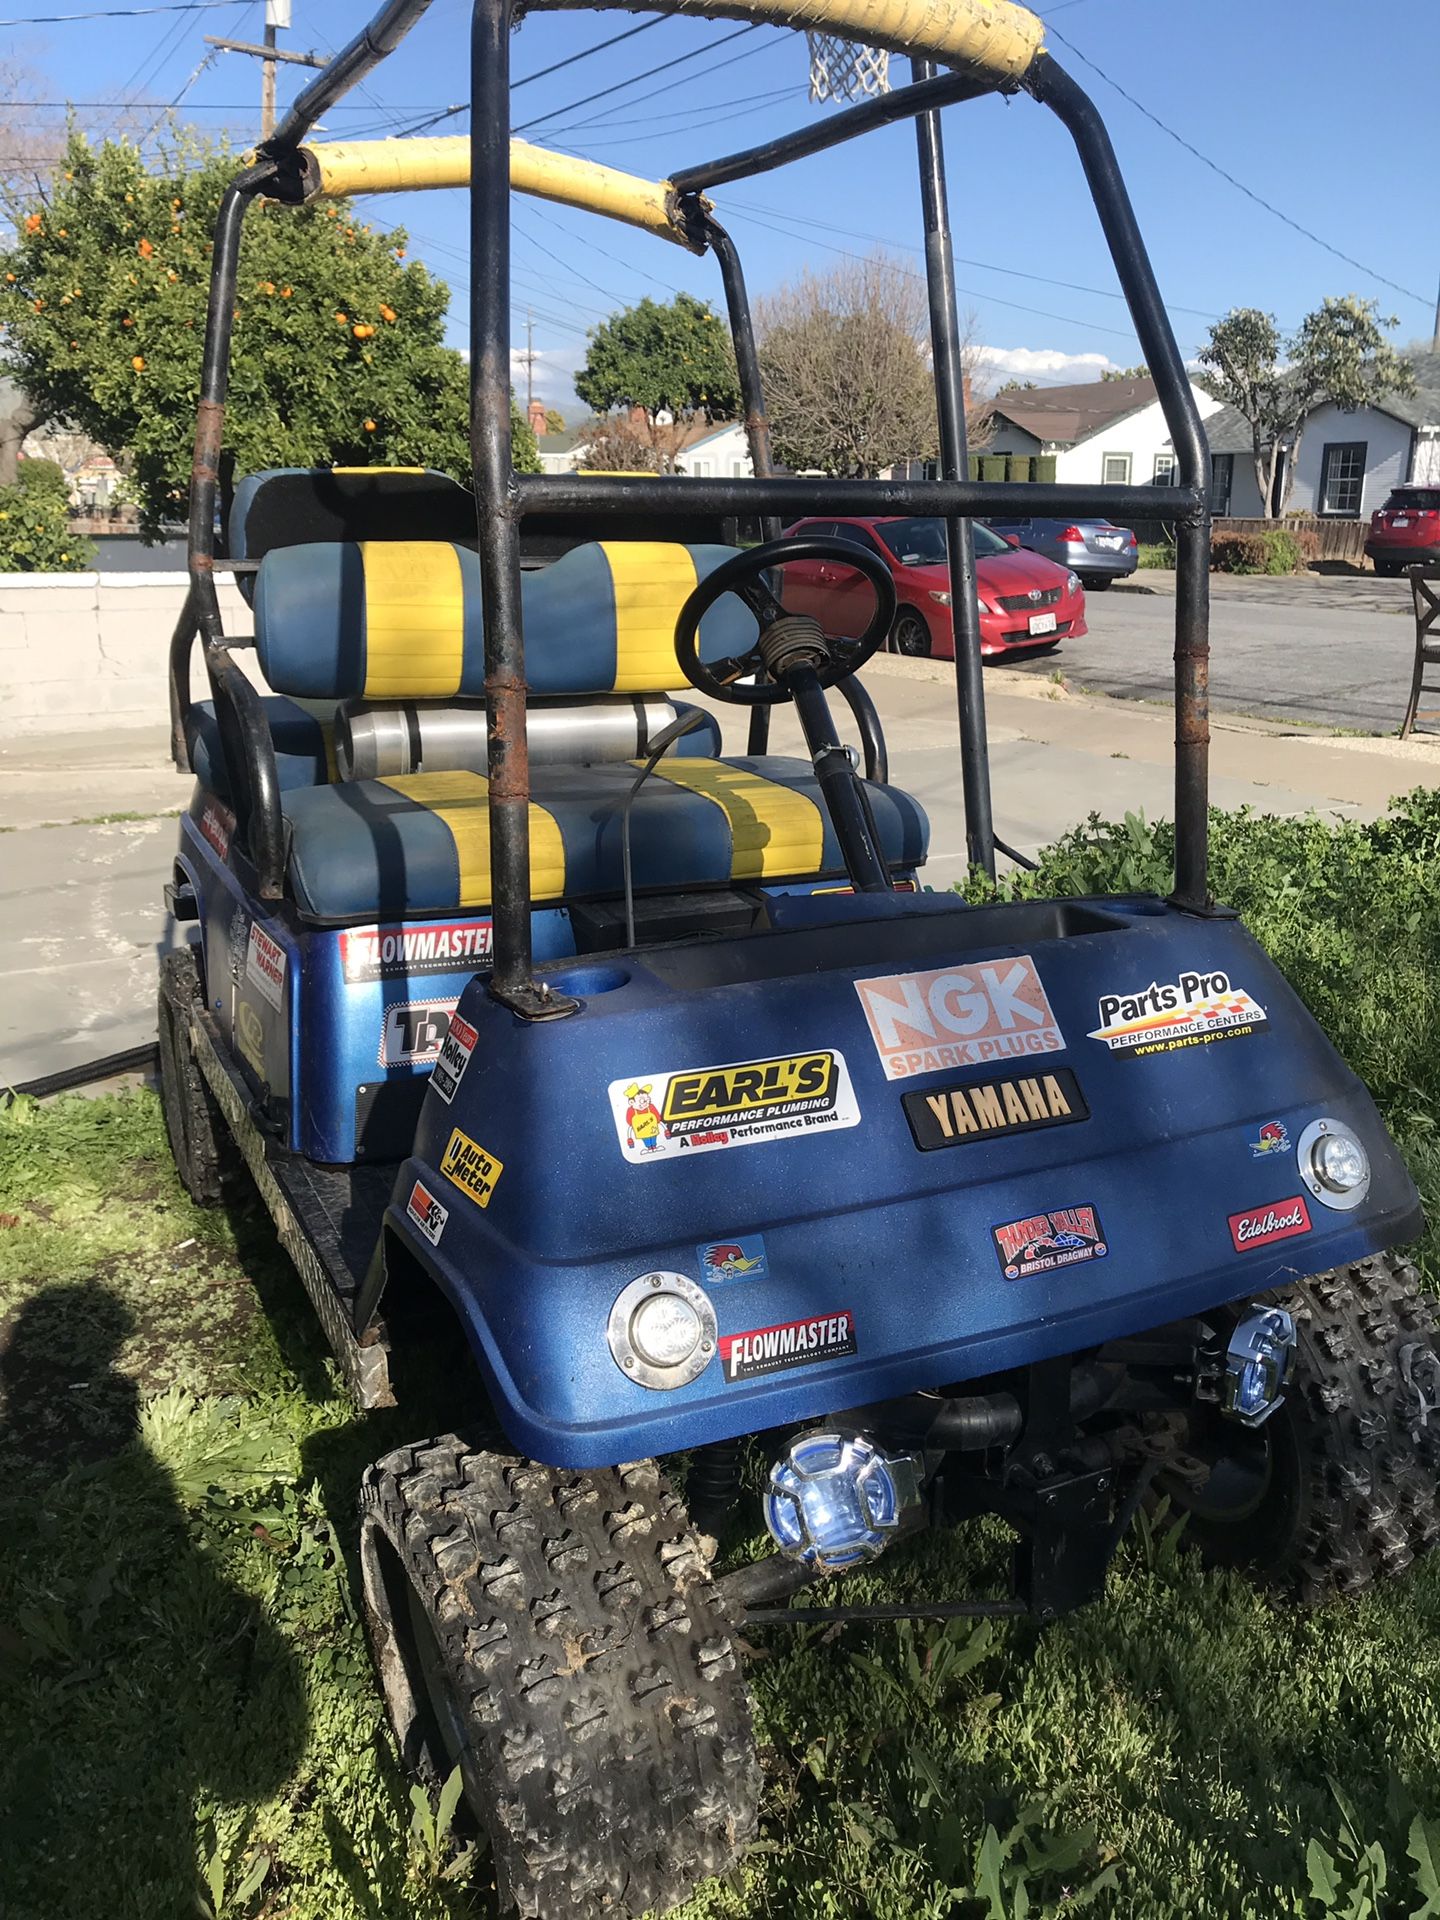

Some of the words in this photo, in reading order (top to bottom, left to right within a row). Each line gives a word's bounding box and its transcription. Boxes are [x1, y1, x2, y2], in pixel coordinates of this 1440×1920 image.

[251, 926, 281, 965] STEWART
[419, 960, 465, 969] TECHNOLOGY
[256, 948, 282, 988] WARNER
[863, 962, 1045, 1049] NGK
[1100, 982, 1178, 1028] Parts
[1181, 973, 1228, 1003] Pro
[1111, 1021, 1205, 1048] PERFORMANCE
[1207, 1010, 1262, 1029] CENTERS
[1135, 1025, 1253, 1056] www.parts-pro.com
[441, 1036, 467, 1078] Holley
[889, 1044, 975, 1077] SPARK
[977, 1031, 1060, 1061] PLUGS
[671, 1060, 824, 1112] EARL'S
[671, 1110, 764, 1133] PERFORMANCE
[766, 1097, 830, 1118] PLUMBING
[925, 1074, 1072, 1138] YAMAHA
[679, 1136, 690, 1148] A
[690, 1131, 729, 1147] Holley
[730, 1120, 803, 1139] Performance
[804, 1111, 839, 1127] Brand
[452, 1158, 490, 1195] Meter
[460, 1144, 491, 1176] Auto
[994, 1214, 1053, 1264] THUNDER
[1047, 1206, 1100, 1242] VALLEY
[1237, 1206, 1303, 1242] Edelbrock
[1020, 1257, 1056, 1274] BRISTOL
[1057, 1246, 1094, 1265] DRAGWAY
[730, 1316, 848, 1377] FLOWMASTER
[756, 1360, 782, 1370] EXHAUST
[784, 1351, 821, 1363] TECHNOLOGY
[823, 1345, 850, 1354] COMPANY
